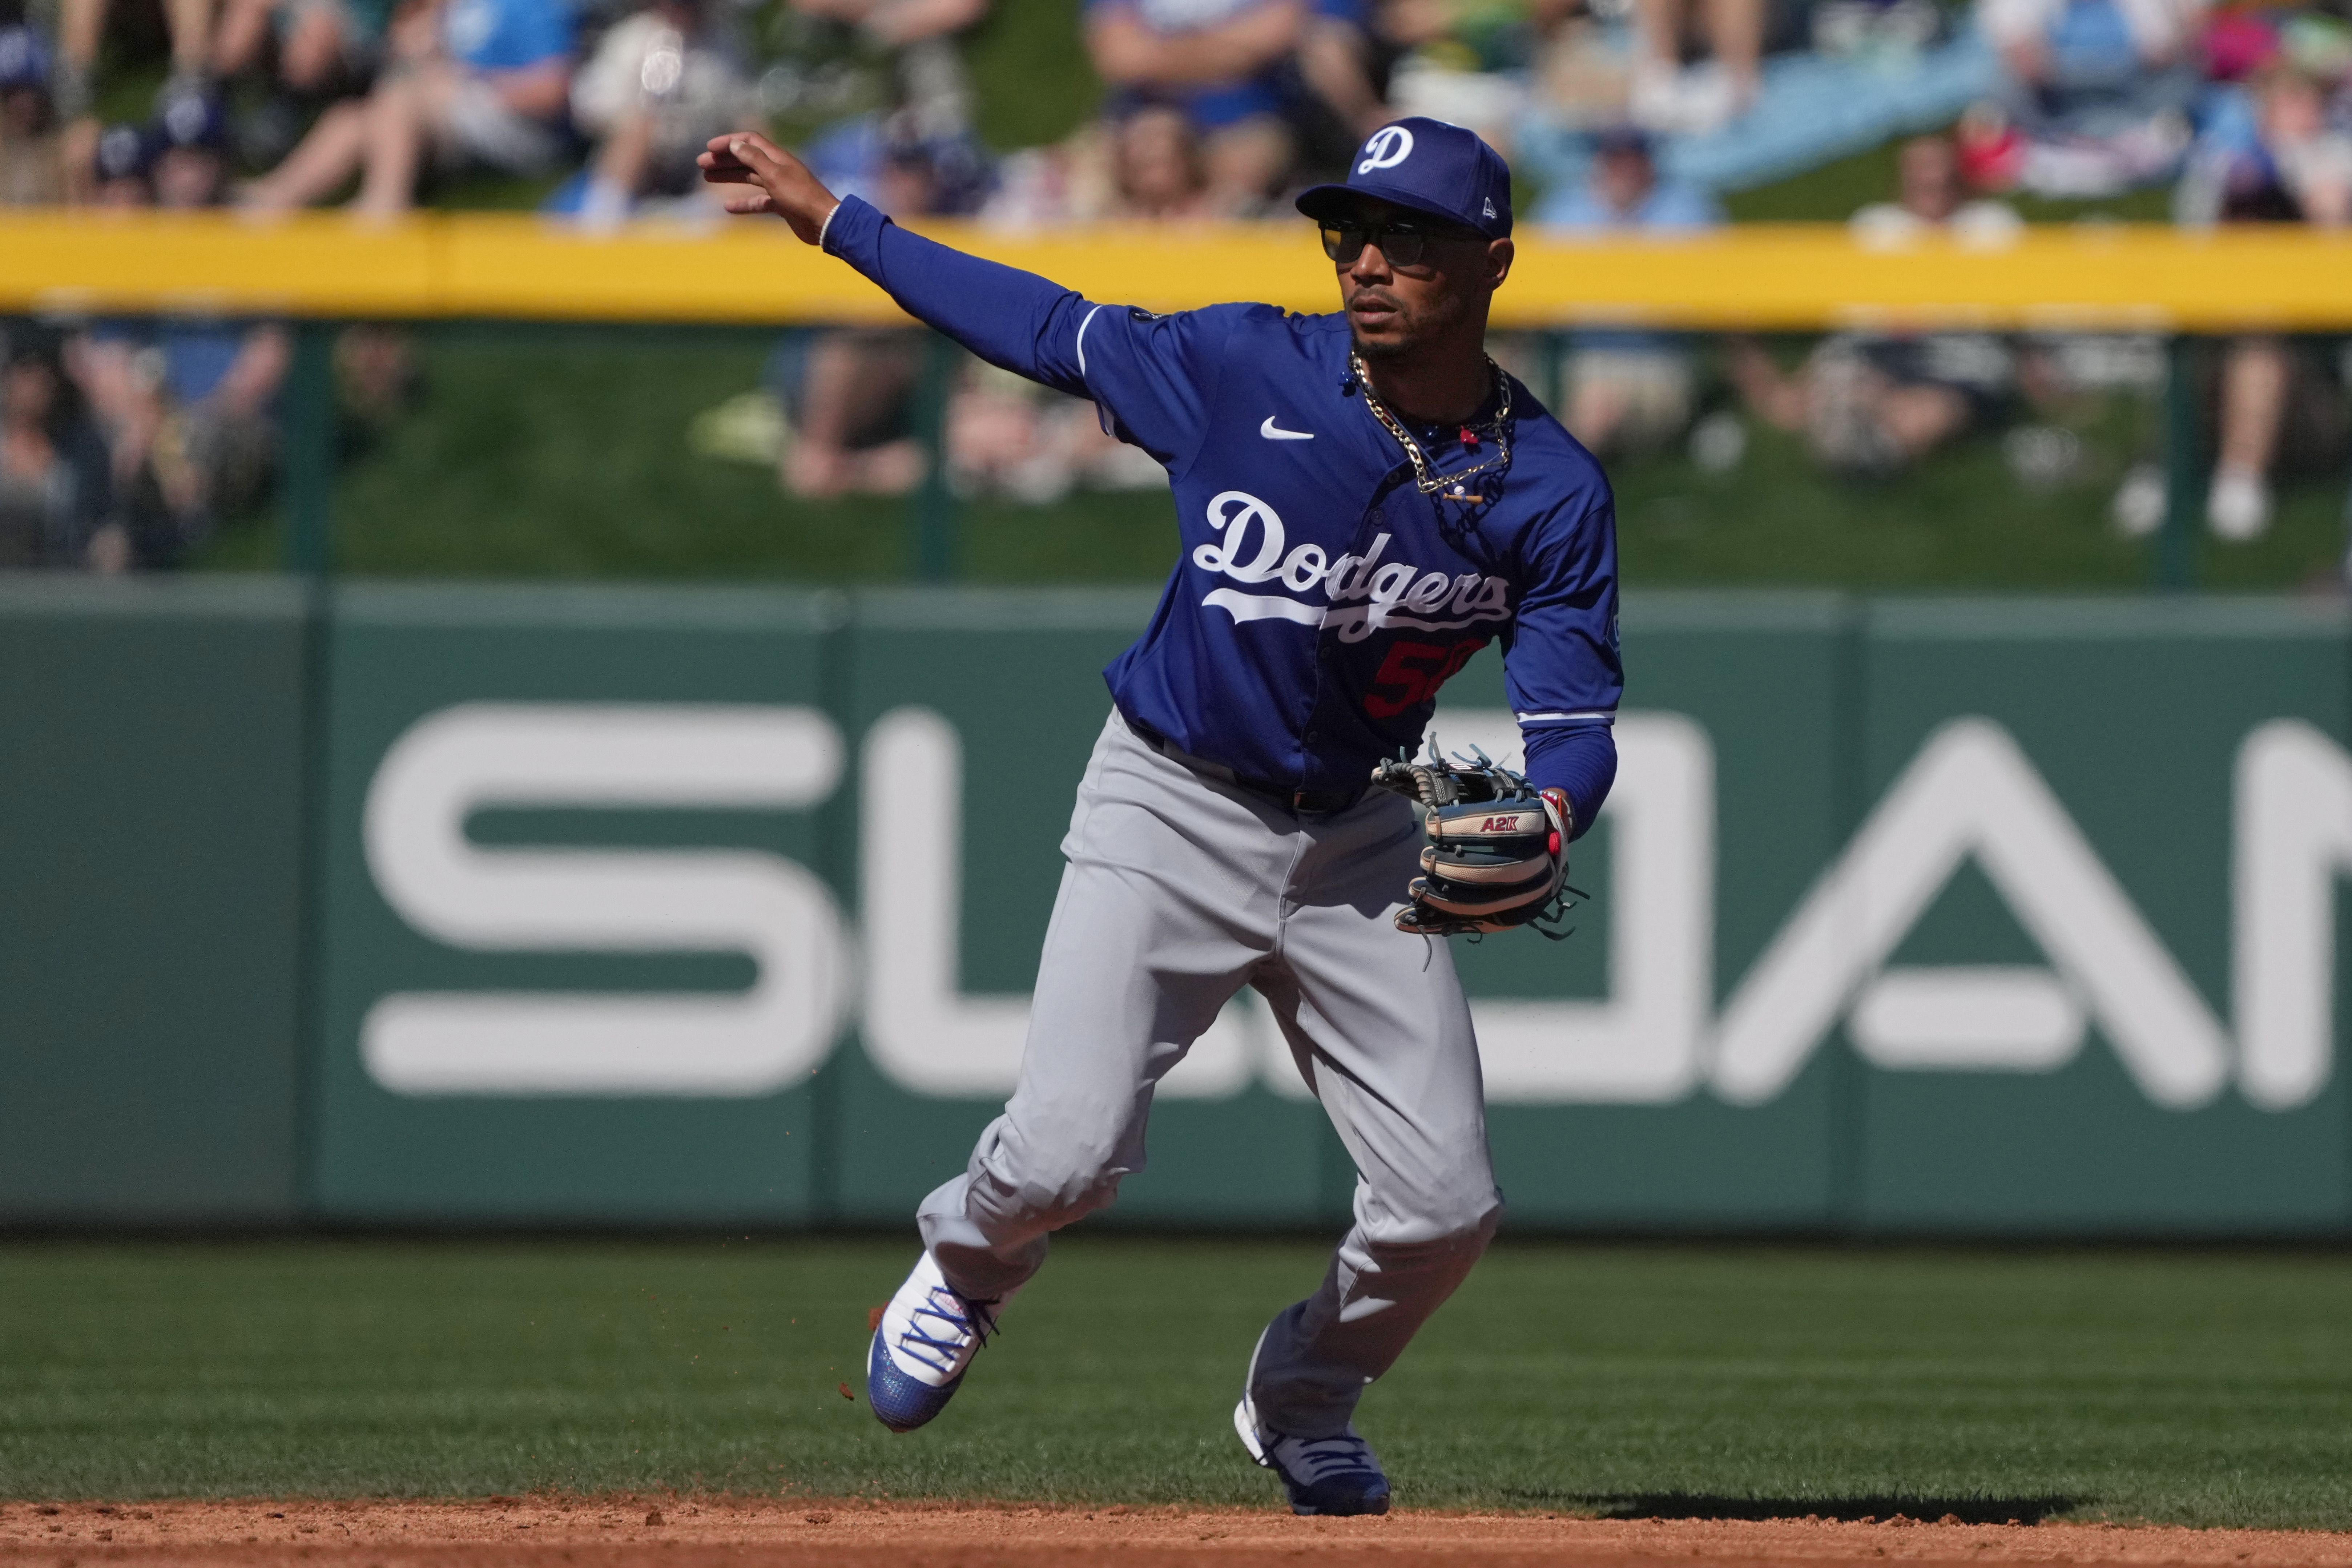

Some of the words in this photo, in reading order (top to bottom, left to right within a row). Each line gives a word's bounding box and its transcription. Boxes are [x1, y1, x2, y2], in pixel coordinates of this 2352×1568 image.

[1357, 125, 1414, 175] D
[1192, 490, 1512, 644] Dodgers
[1480, 815, 1519, 832] A2K
